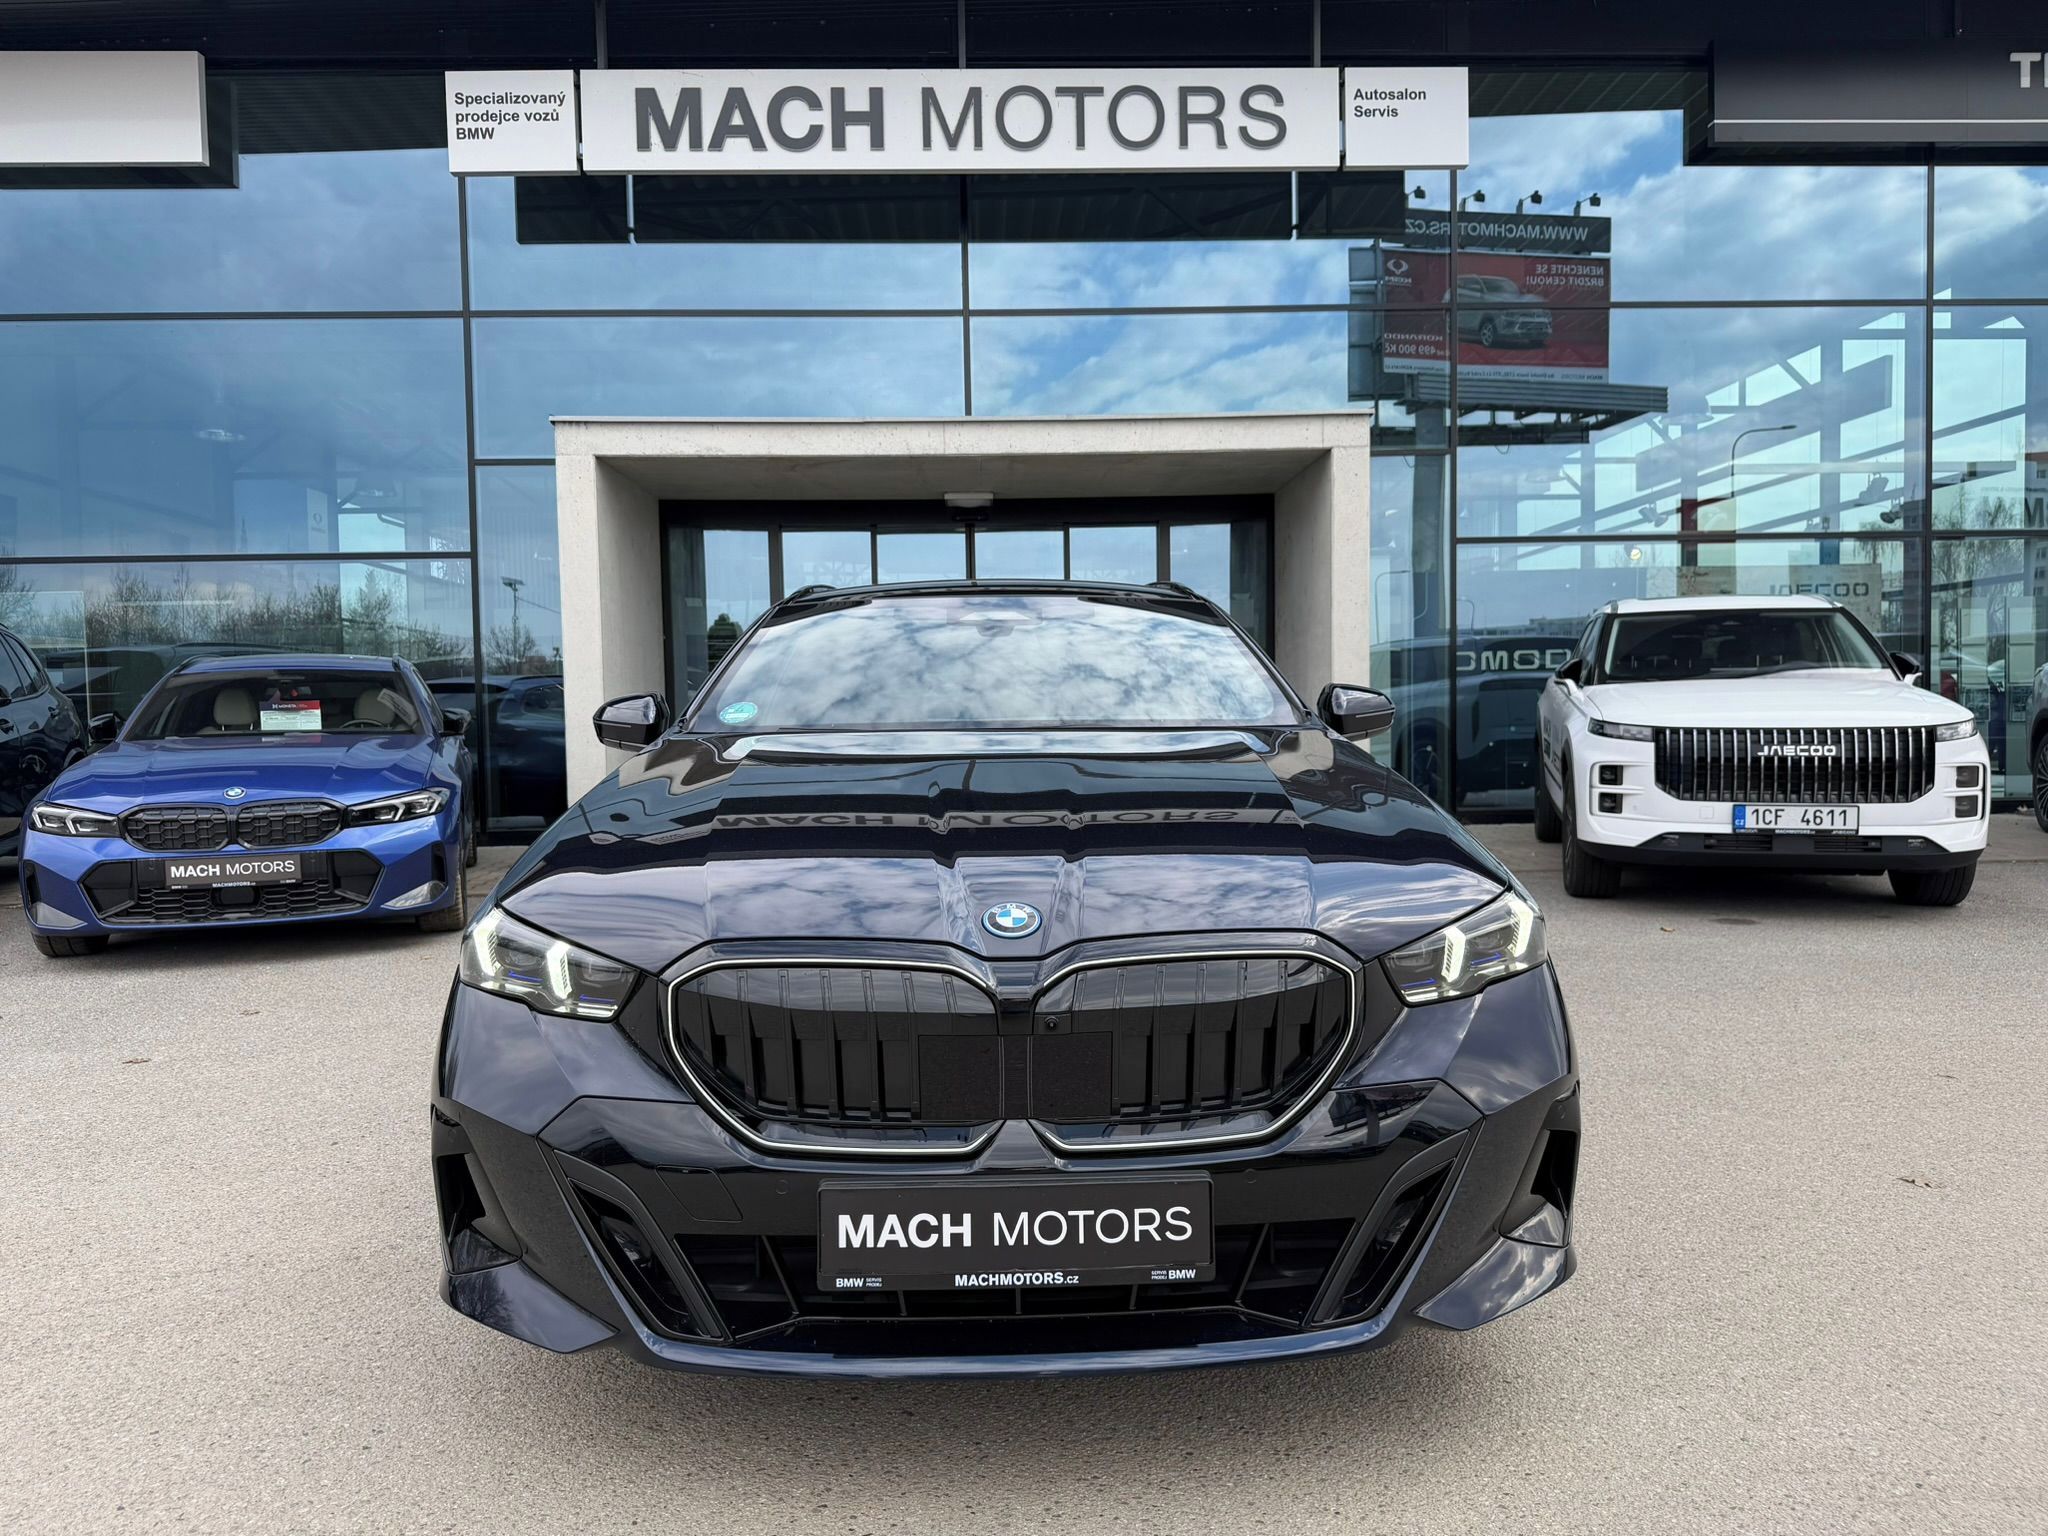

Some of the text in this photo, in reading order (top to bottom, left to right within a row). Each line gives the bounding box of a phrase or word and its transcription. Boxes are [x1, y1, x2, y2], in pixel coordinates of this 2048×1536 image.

[2010, 52, 2048, 88] T
[454, 91, 566, 107] Specializovaný
[1353, 88, 1427, 101] Autosalon
[455, 108, 560, 125] prodejce vozů
[634, 84, 1288, 152] MACH MOTORS
[1353, 105, 1399, 118] Servis
[456, 127, 495, 140] BMW
[1757, 745, 1836, 756] JAECOO
[1751, 808, 1785, 826] 1CF
[1800, 809, 1848, 827] 4611
[170, 860, 296, 878] MACH MOTORS
[837, 1206, 1194, 1249] MACH MOTORS
[835, 1277, 864, 1288] BMW
[954, 1271, 1080, 1288] MACHMOTORS.cz
[1168, 1269, 1196, 1281] BMW
